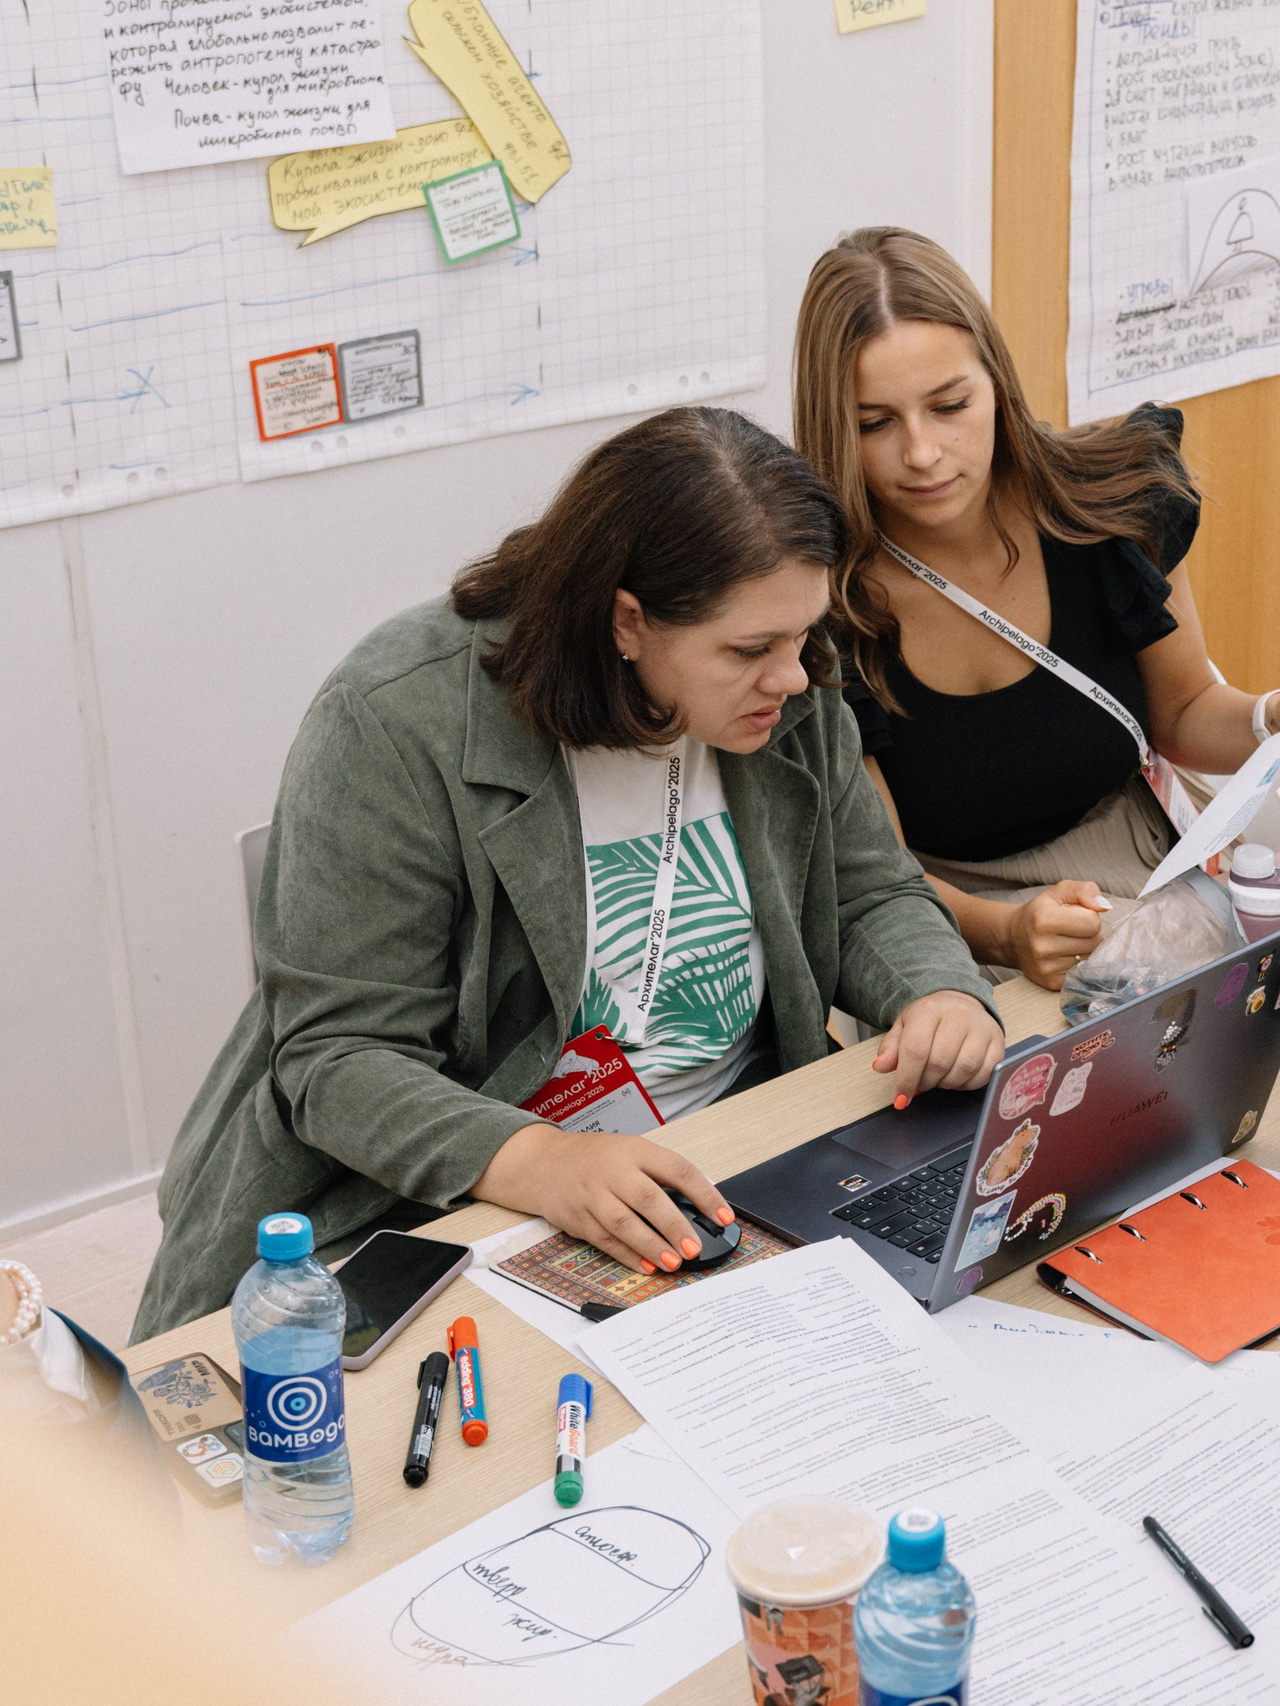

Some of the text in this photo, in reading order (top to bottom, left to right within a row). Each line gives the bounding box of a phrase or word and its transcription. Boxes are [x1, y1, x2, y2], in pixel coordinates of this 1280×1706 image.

[110, 40, 178, 65] которая
[188, 33, 269, 51] глобально
[271, 22, 345, 44] позволит
[111, 61, 173, 84] режить
[243, 72, 286, 95] купол
[291, 64, 349, 81] жизни
[267, 75, 385, 105] для микробиома
[174, 109, 222, 129] Почва
[238, 110, 280, 129] купол
[284, 105, 341, 123] жизни
[347, 99, 370, 121] для
[1110, 1090, 1168, 1127] HUAWEI
